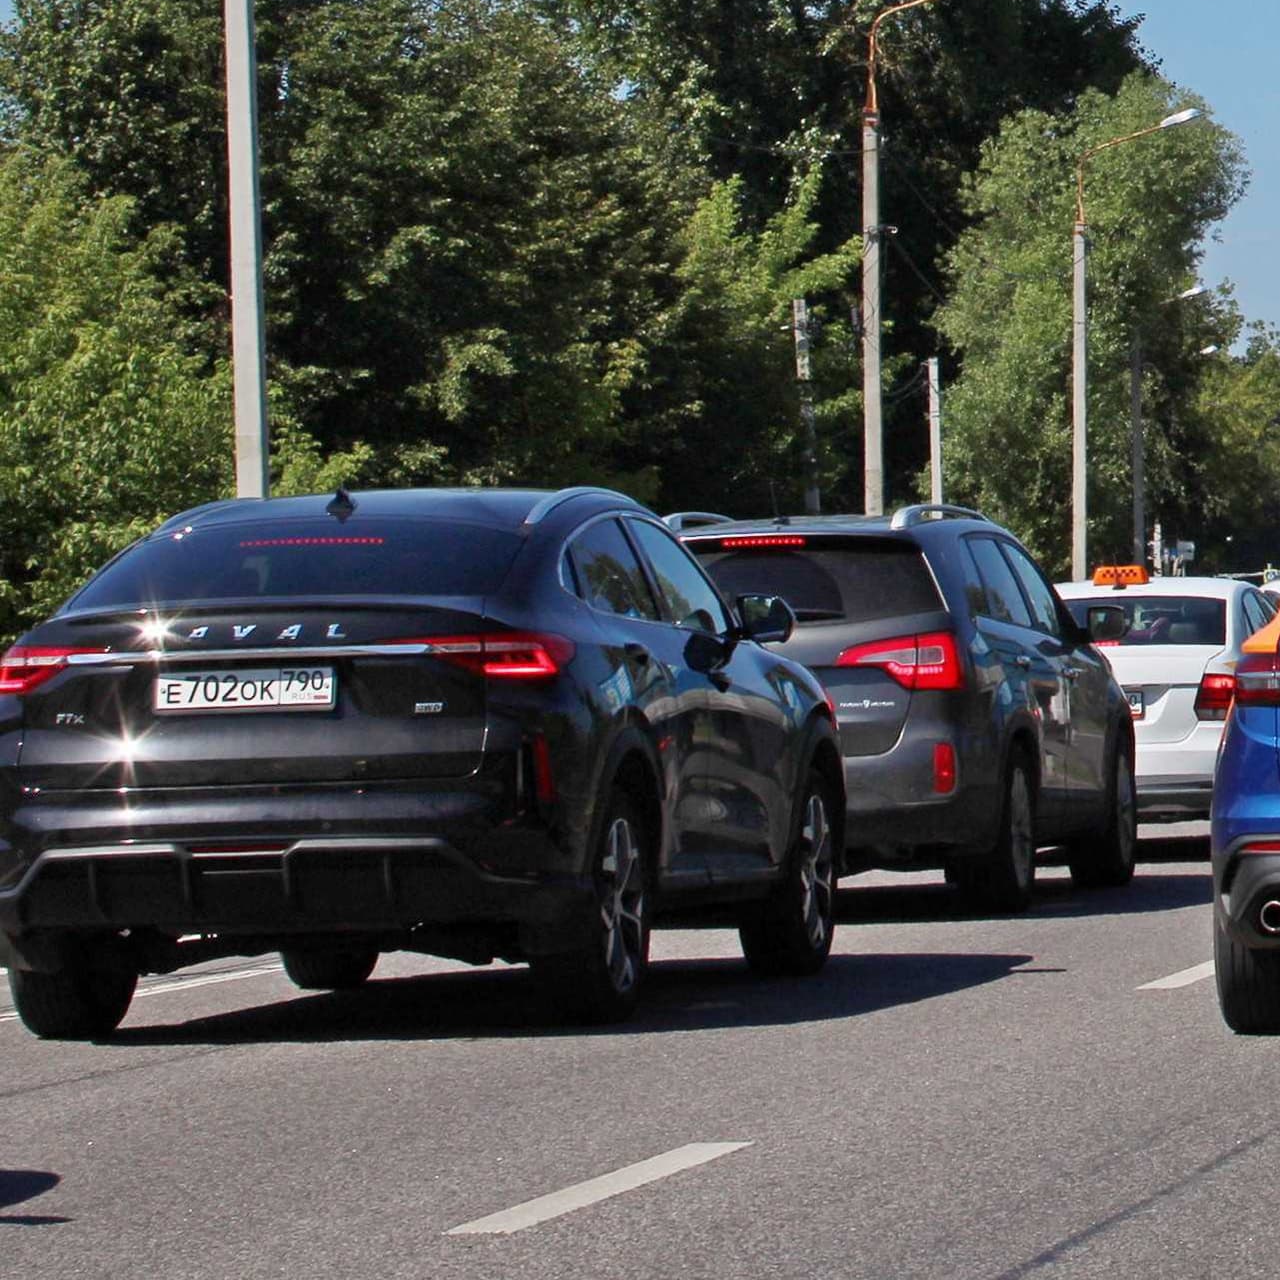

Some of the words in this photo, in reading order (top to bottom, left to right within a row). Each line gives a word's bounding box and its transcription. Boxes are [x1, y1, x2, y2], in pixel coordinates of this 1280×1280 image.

[188, 623, 347, 641] AVAL
[166, 675, 274, 705] Е702ОК
[284, 670, 325, 693] 790
